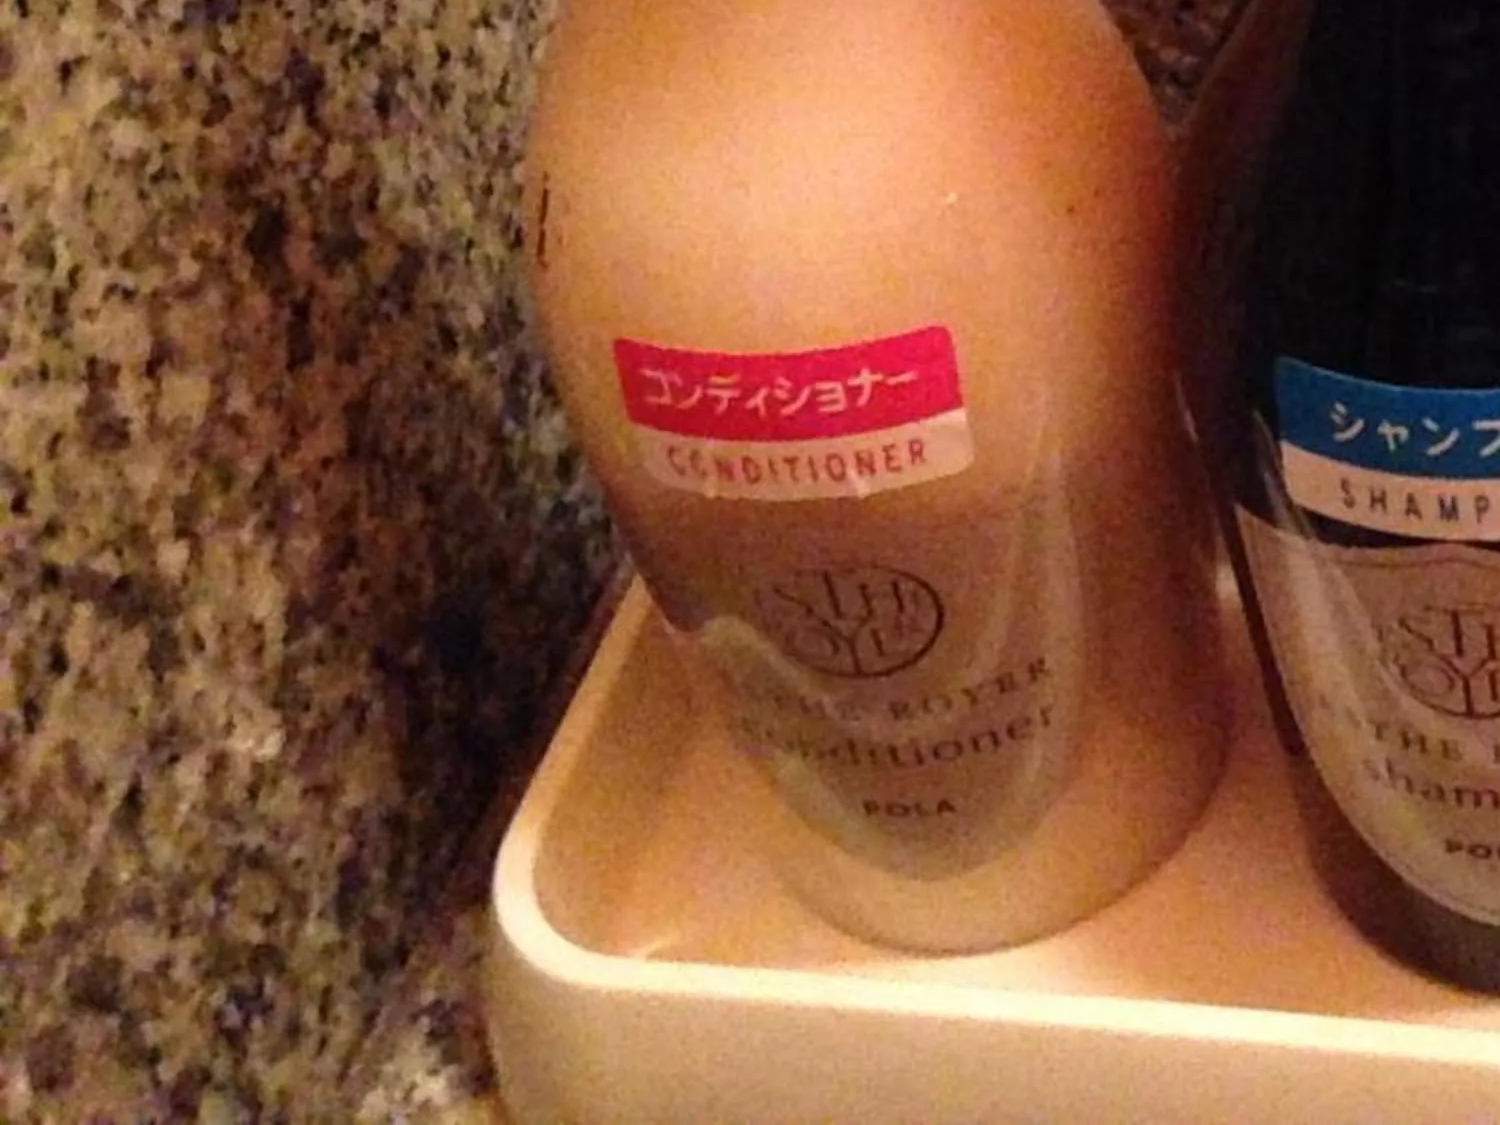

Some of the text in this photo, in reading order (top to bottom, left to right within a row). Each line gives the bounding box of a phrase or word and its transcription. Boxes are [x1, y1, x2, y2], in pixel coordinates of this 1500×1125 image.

[641, 367, 918, 417] コンディショナー
[862, 797, 957, 819] POLA
